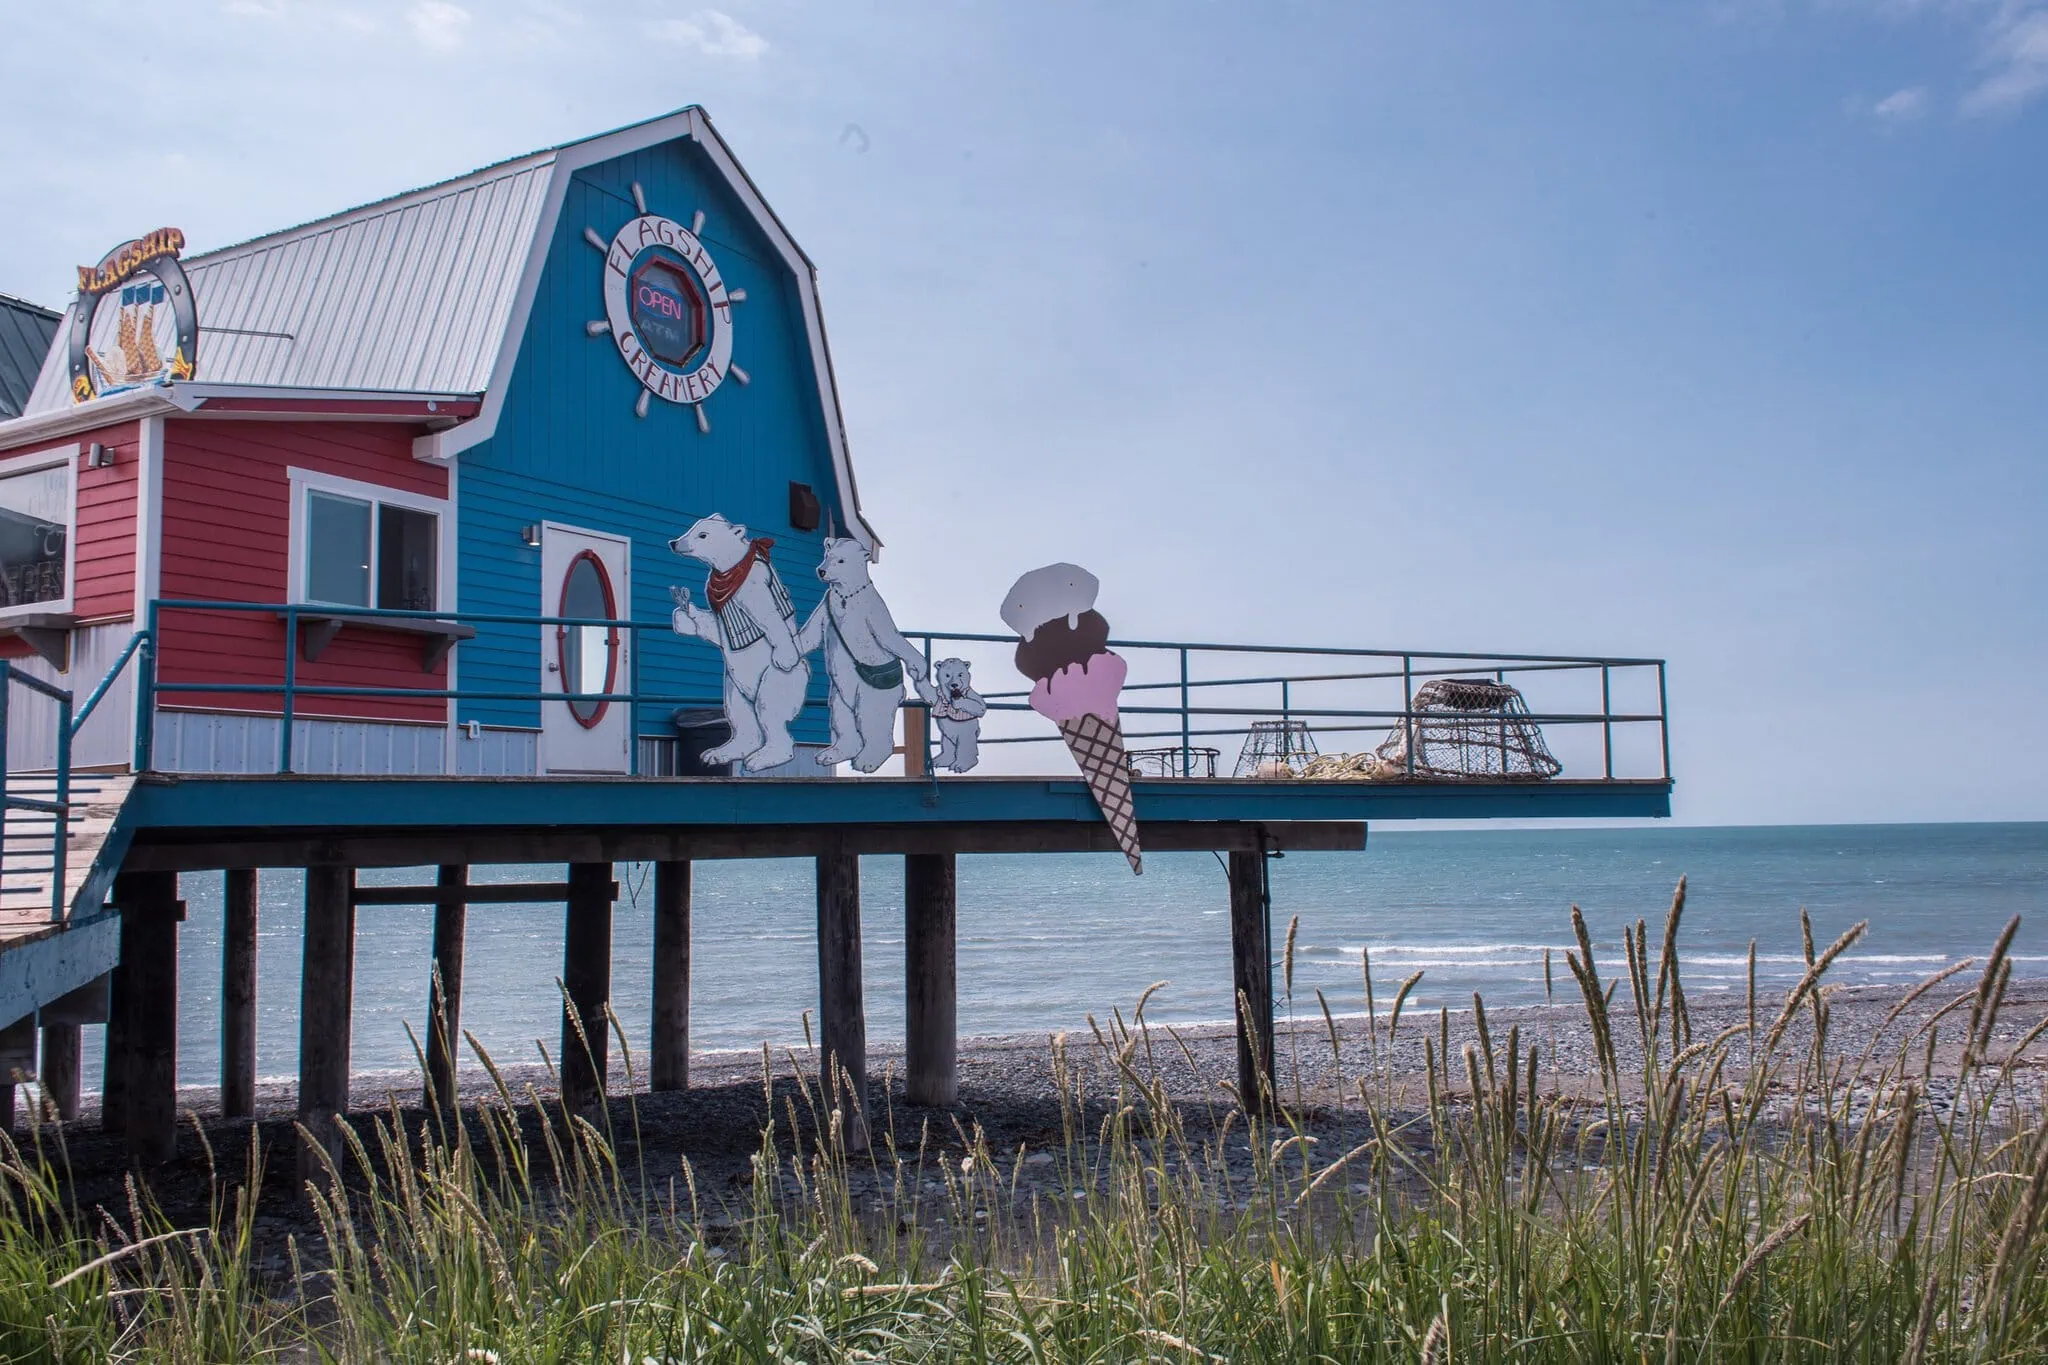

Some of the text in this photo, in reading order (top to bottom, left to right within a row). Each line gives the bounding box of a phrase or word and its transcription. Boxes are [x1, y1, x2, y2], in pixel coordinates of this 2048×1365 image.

[78, 227, 184, 294] FLAGSHIP
[609, 219, 732, 326] FLAGSHIP
[639, 286, 681, 319] OPEN
[620, 331, 722, 401] CREAMERY
